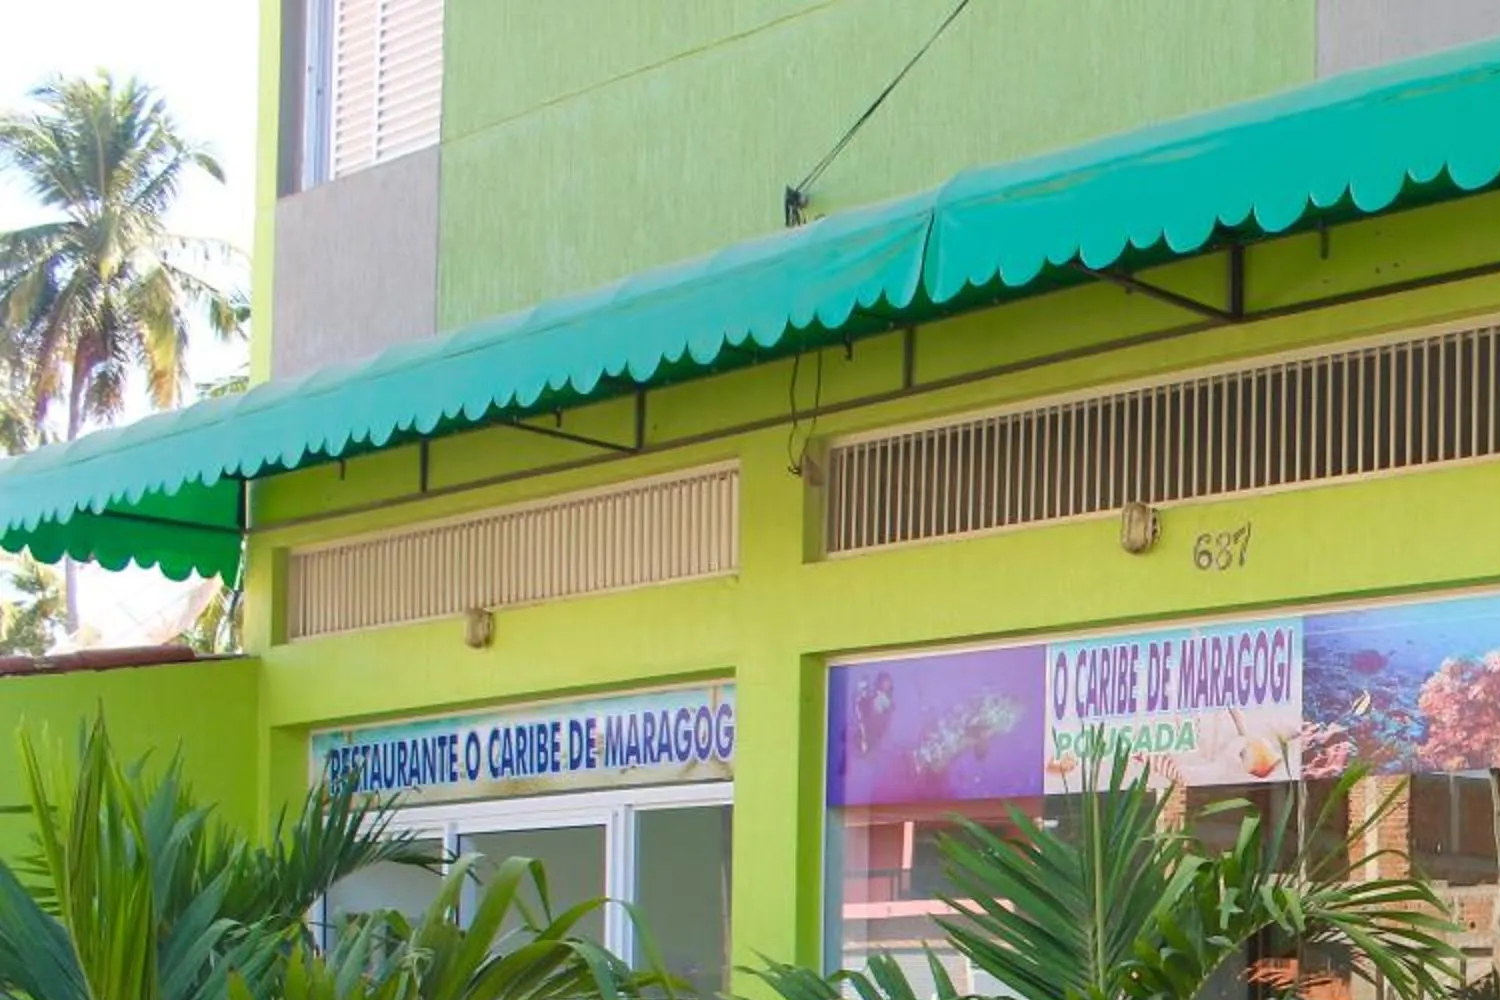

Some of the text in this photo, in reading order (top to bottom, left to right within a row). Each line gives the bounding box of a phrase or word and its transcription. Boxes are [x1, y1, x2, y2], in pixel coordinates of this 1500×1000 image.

[1053, 628, 1294, 720] O CARIBE DE MARAGOGI
[330, 734, 459, 794] RESTAURANTE
[465, 731, 481, 781] O
[488, 721, 561, 779] CARIBE
[569, 718, 597, 771] DE
